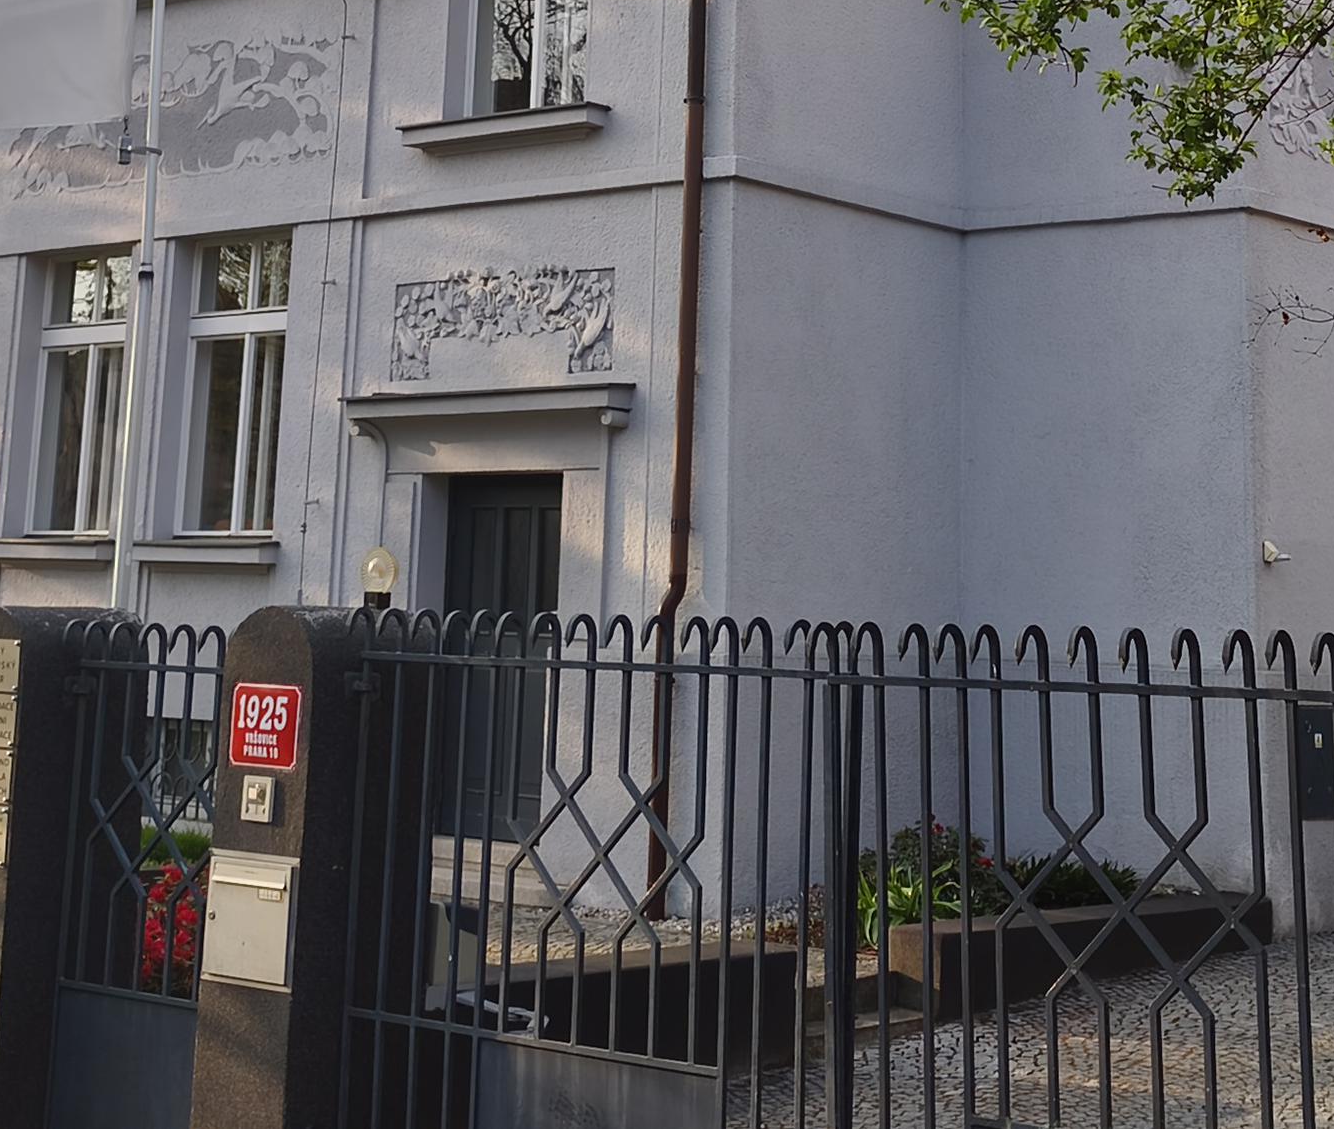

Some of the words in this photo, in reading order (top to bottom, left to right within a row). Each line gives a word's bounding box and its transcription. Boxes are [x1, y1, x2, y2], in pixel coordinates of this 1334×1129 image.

[237, 694, 289, 731] 1925
[245, 731, 278, 745] VRŠOVICE
[243, 745, 268, 759] PRAHA
[269, 746, 279, 760] 10
